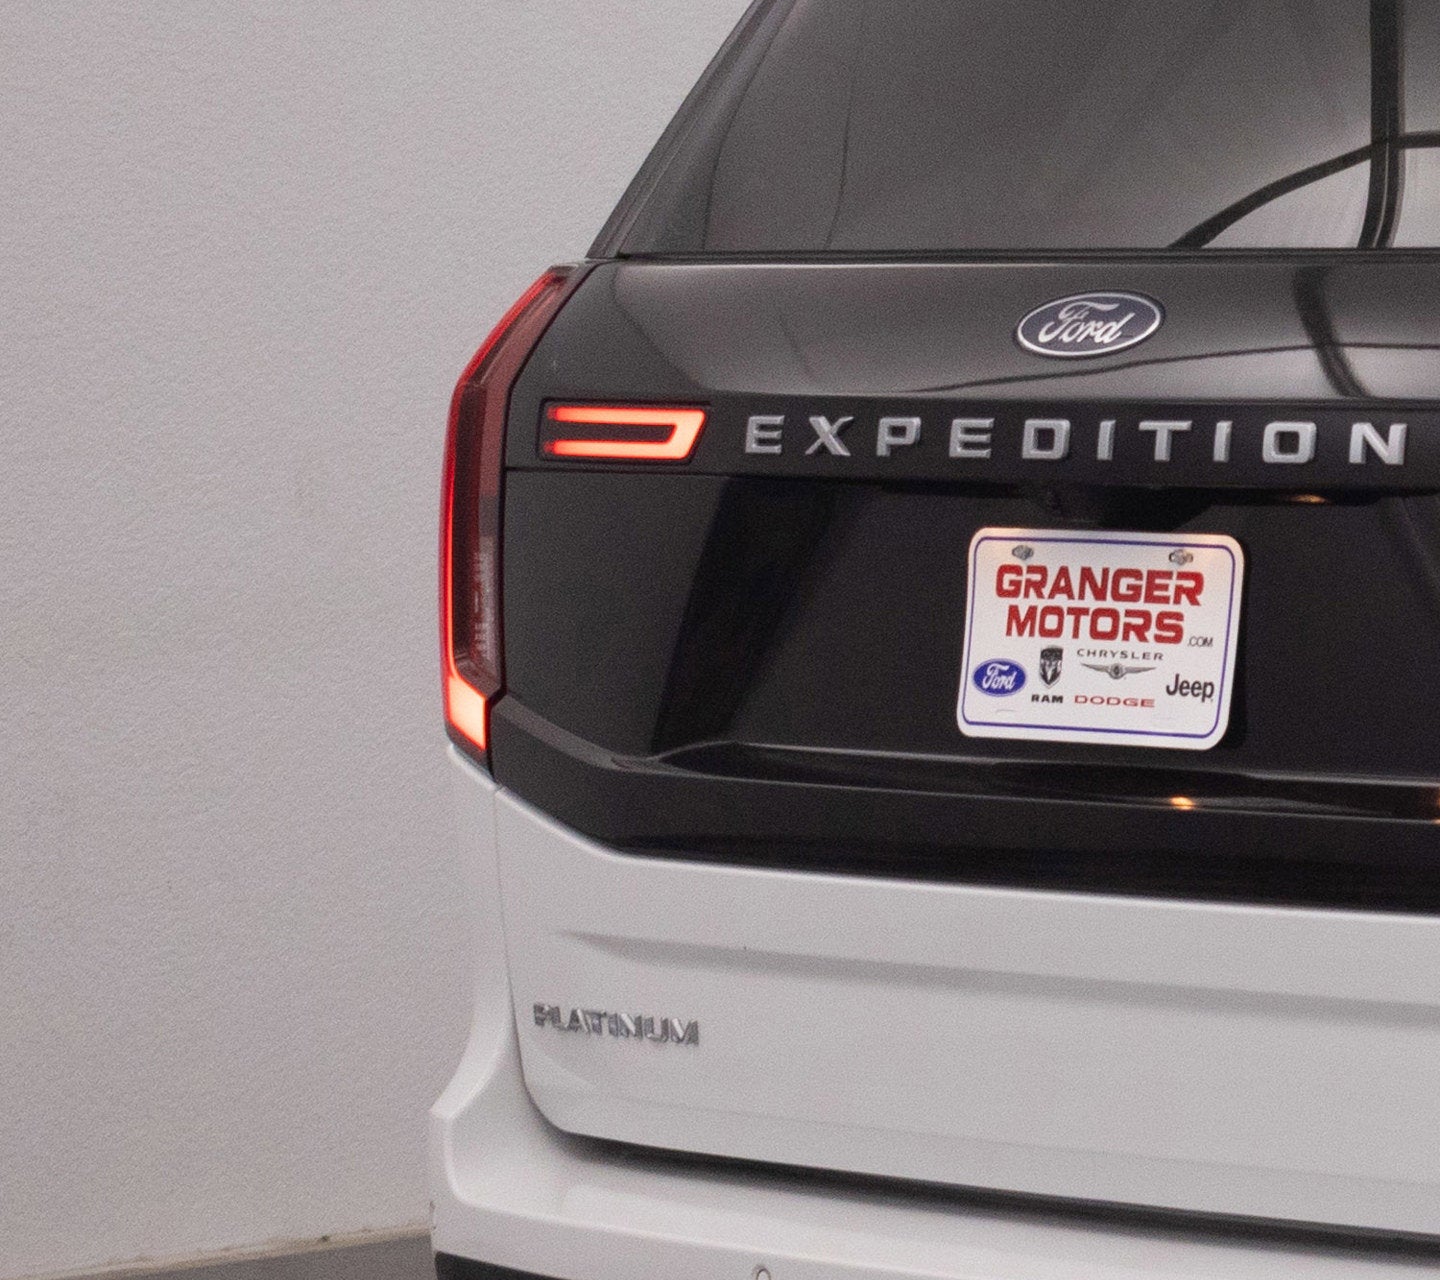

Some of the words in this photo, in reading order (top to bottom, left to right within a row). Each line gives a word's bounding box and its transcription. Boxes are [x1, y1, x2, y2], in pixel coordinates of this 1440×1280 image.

[1037, 300, 1136, 344] Ford
[745, 414, 1408, 466] EXPEDITION
[995, 563, 1205, 607] GRANGER
[1005, 604, 1185, 645] MOTORS
[1076, 648, 1165, 662] CHRYSLER
[981, 662, 1019, 691] Ford
[1166, 673, 1216, 704] Jeep
[1031, 694, 1064, 705] RAM
[1073, 694, 1156, 709] DODGE
[533, 1003, 700, 1046] PLATINUM
